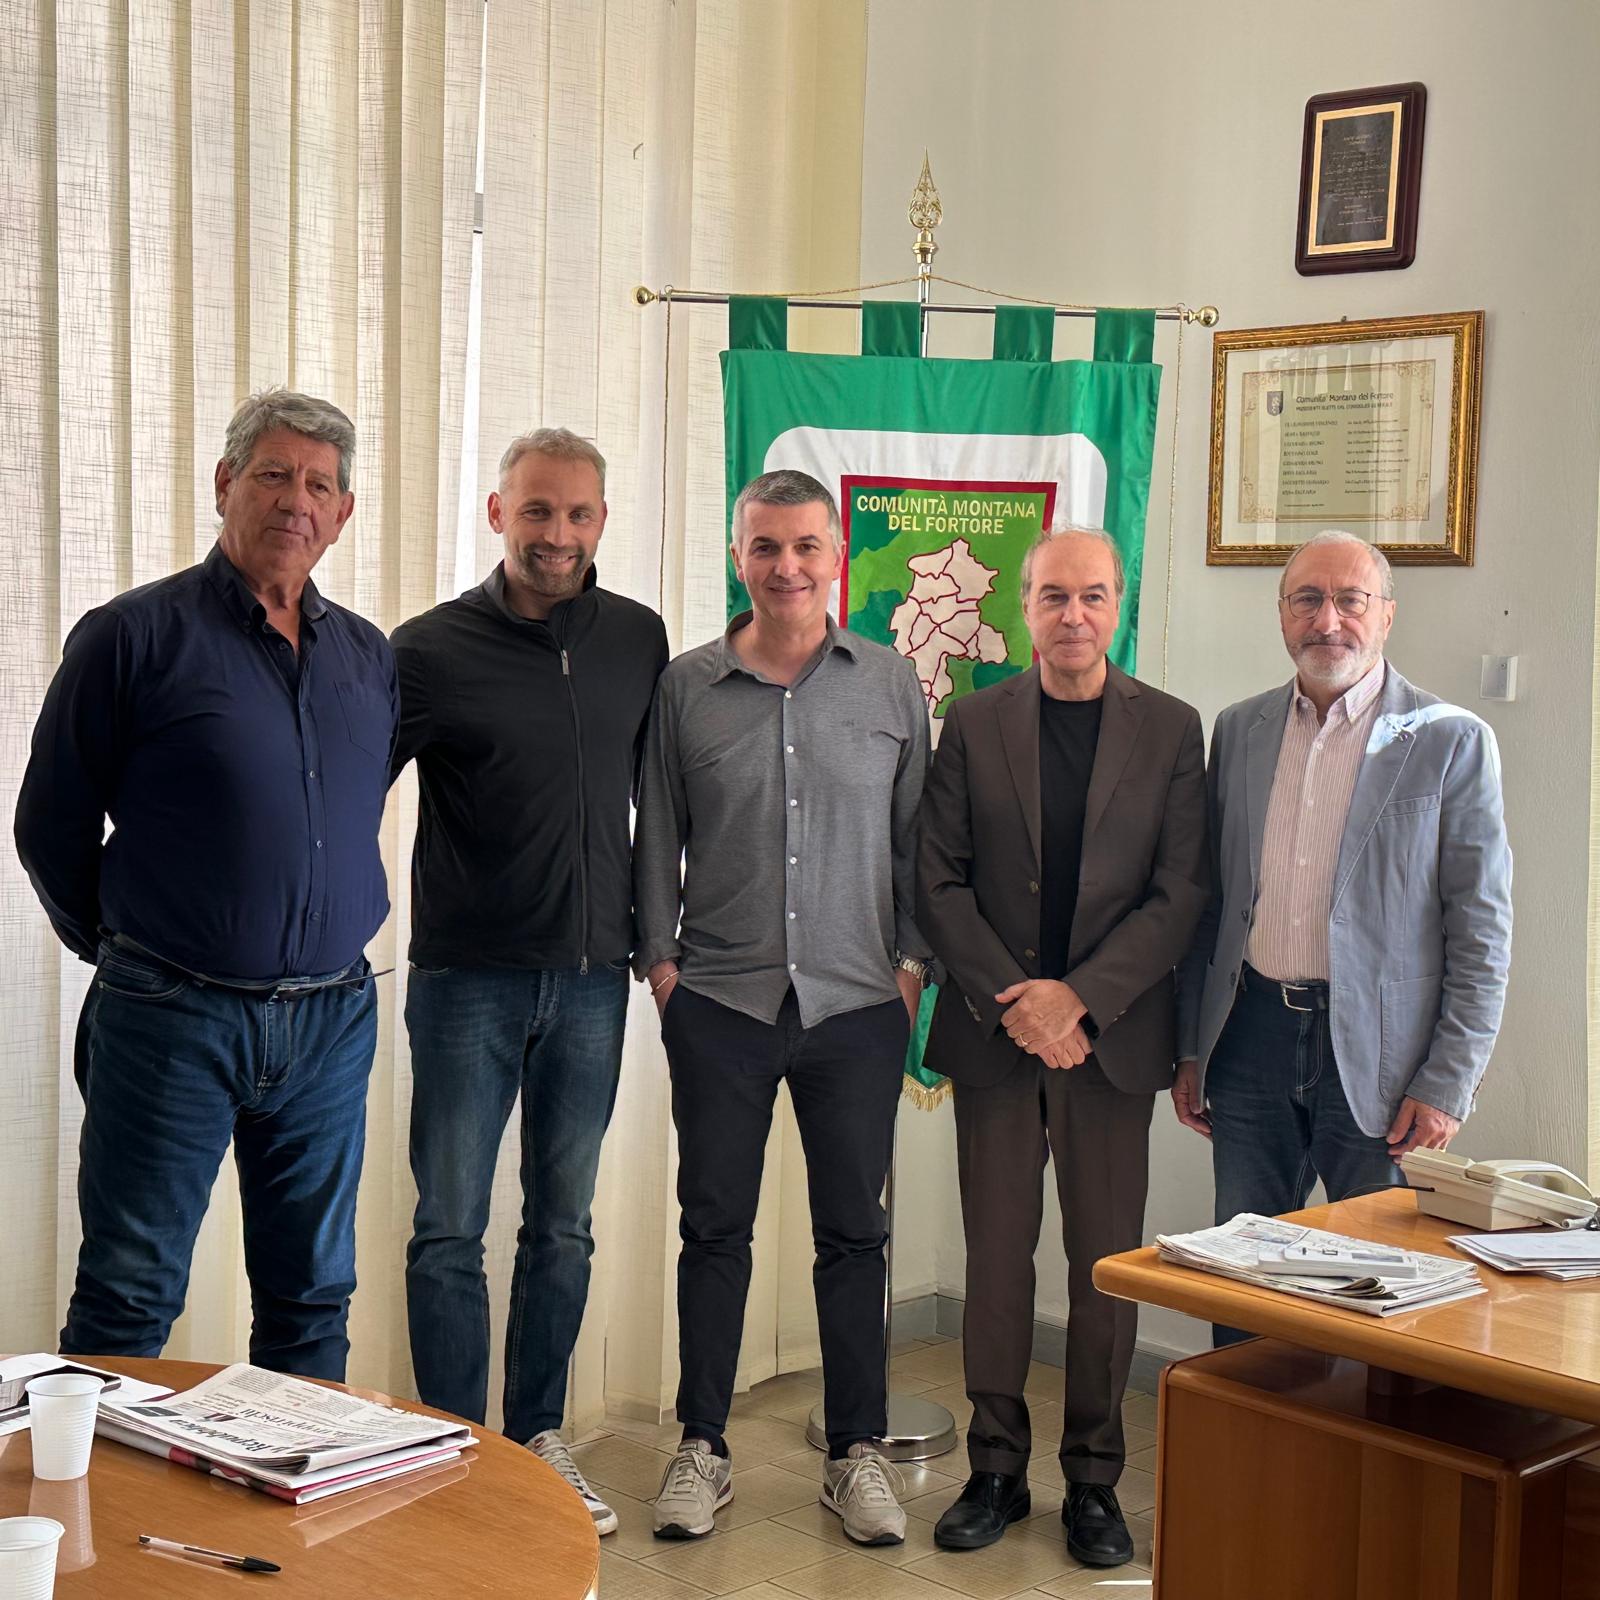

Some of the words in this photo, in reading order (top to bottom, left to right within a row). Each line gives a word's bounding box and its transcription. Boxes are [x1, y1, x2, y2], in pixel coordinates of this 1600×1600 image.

[857, 494, 948, 515] COMUNITÀ
[953, 500, 1036, 518] MONTANA
[888, 515, 921, 532] DEL
[925, 516, 1004, 534] FORTORE
